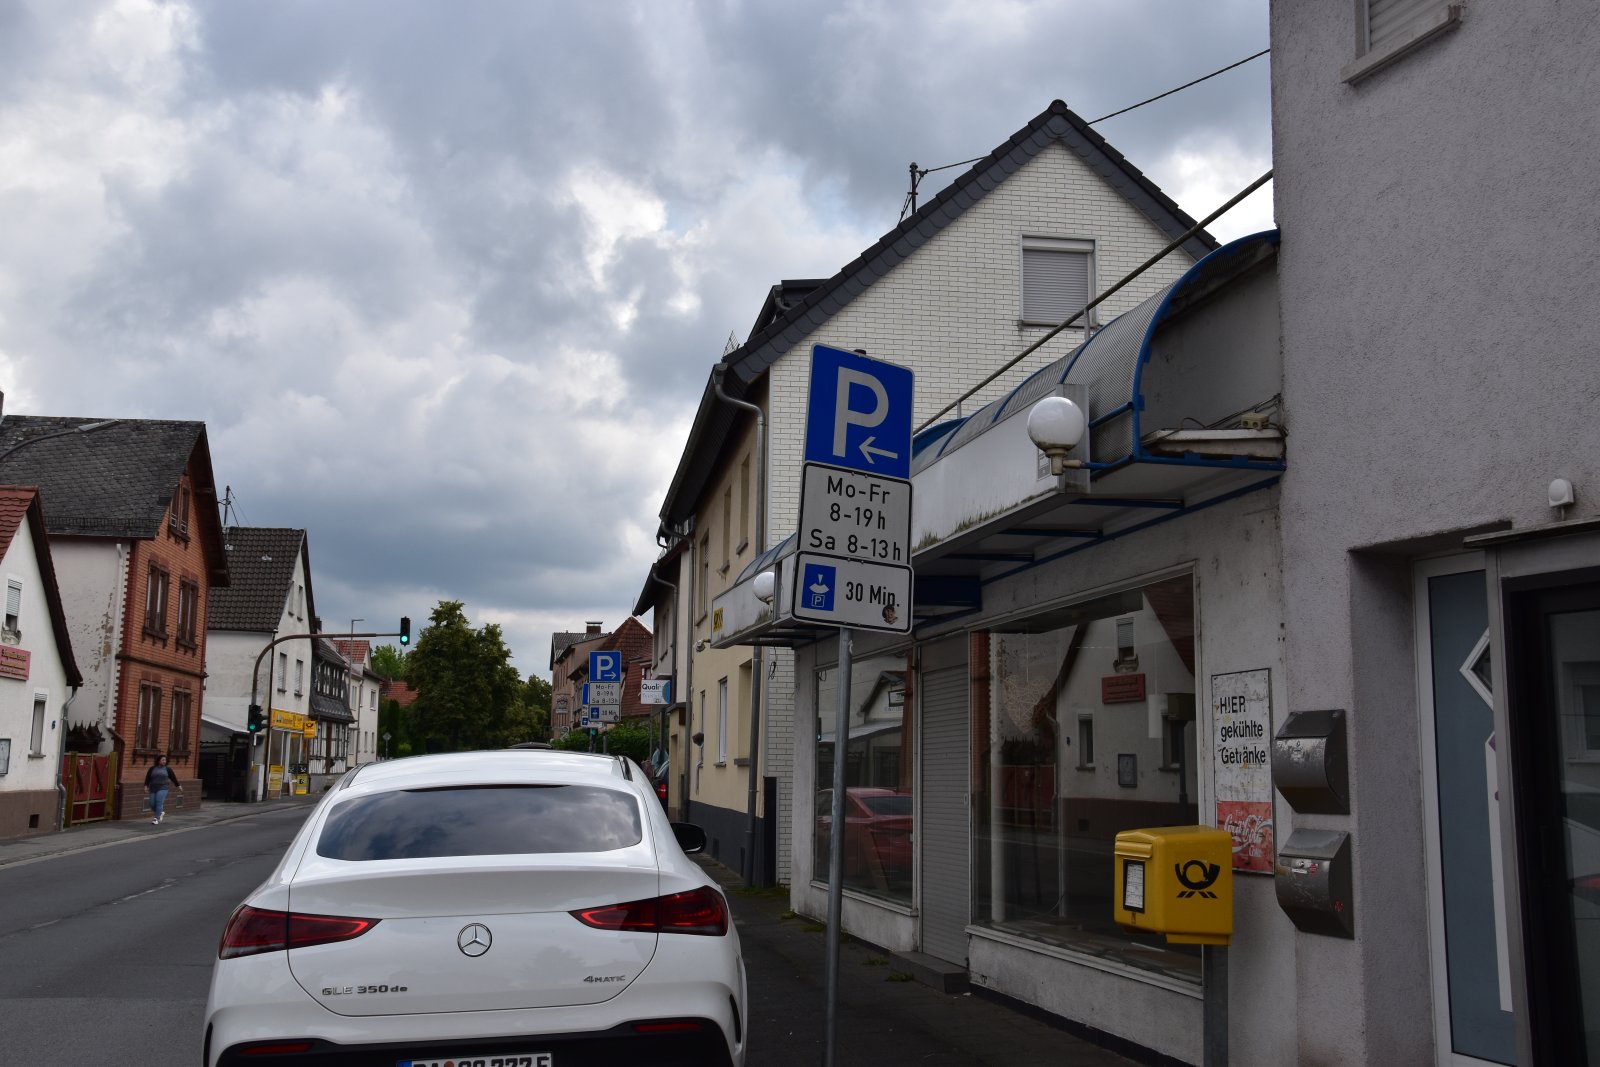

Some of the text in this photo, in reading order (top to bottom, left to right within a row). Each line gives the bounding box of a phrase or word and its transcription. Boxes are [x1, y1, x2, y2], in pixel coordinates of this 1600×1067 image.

[833, 367, 889, 457] P
[827, 475, 890, 504] Mo-Fr
[809, 528, 836, 551] Sa
[845, 580, 863, 602] 30
[597, 656, 613, 679] P
[1220, 719, 1264, 743] gekühlte
[1221, 746, 1266, 766] Getränke
[583, 975, 626, 984] 4MATIC
[322, 987, 353, 996] GLE
